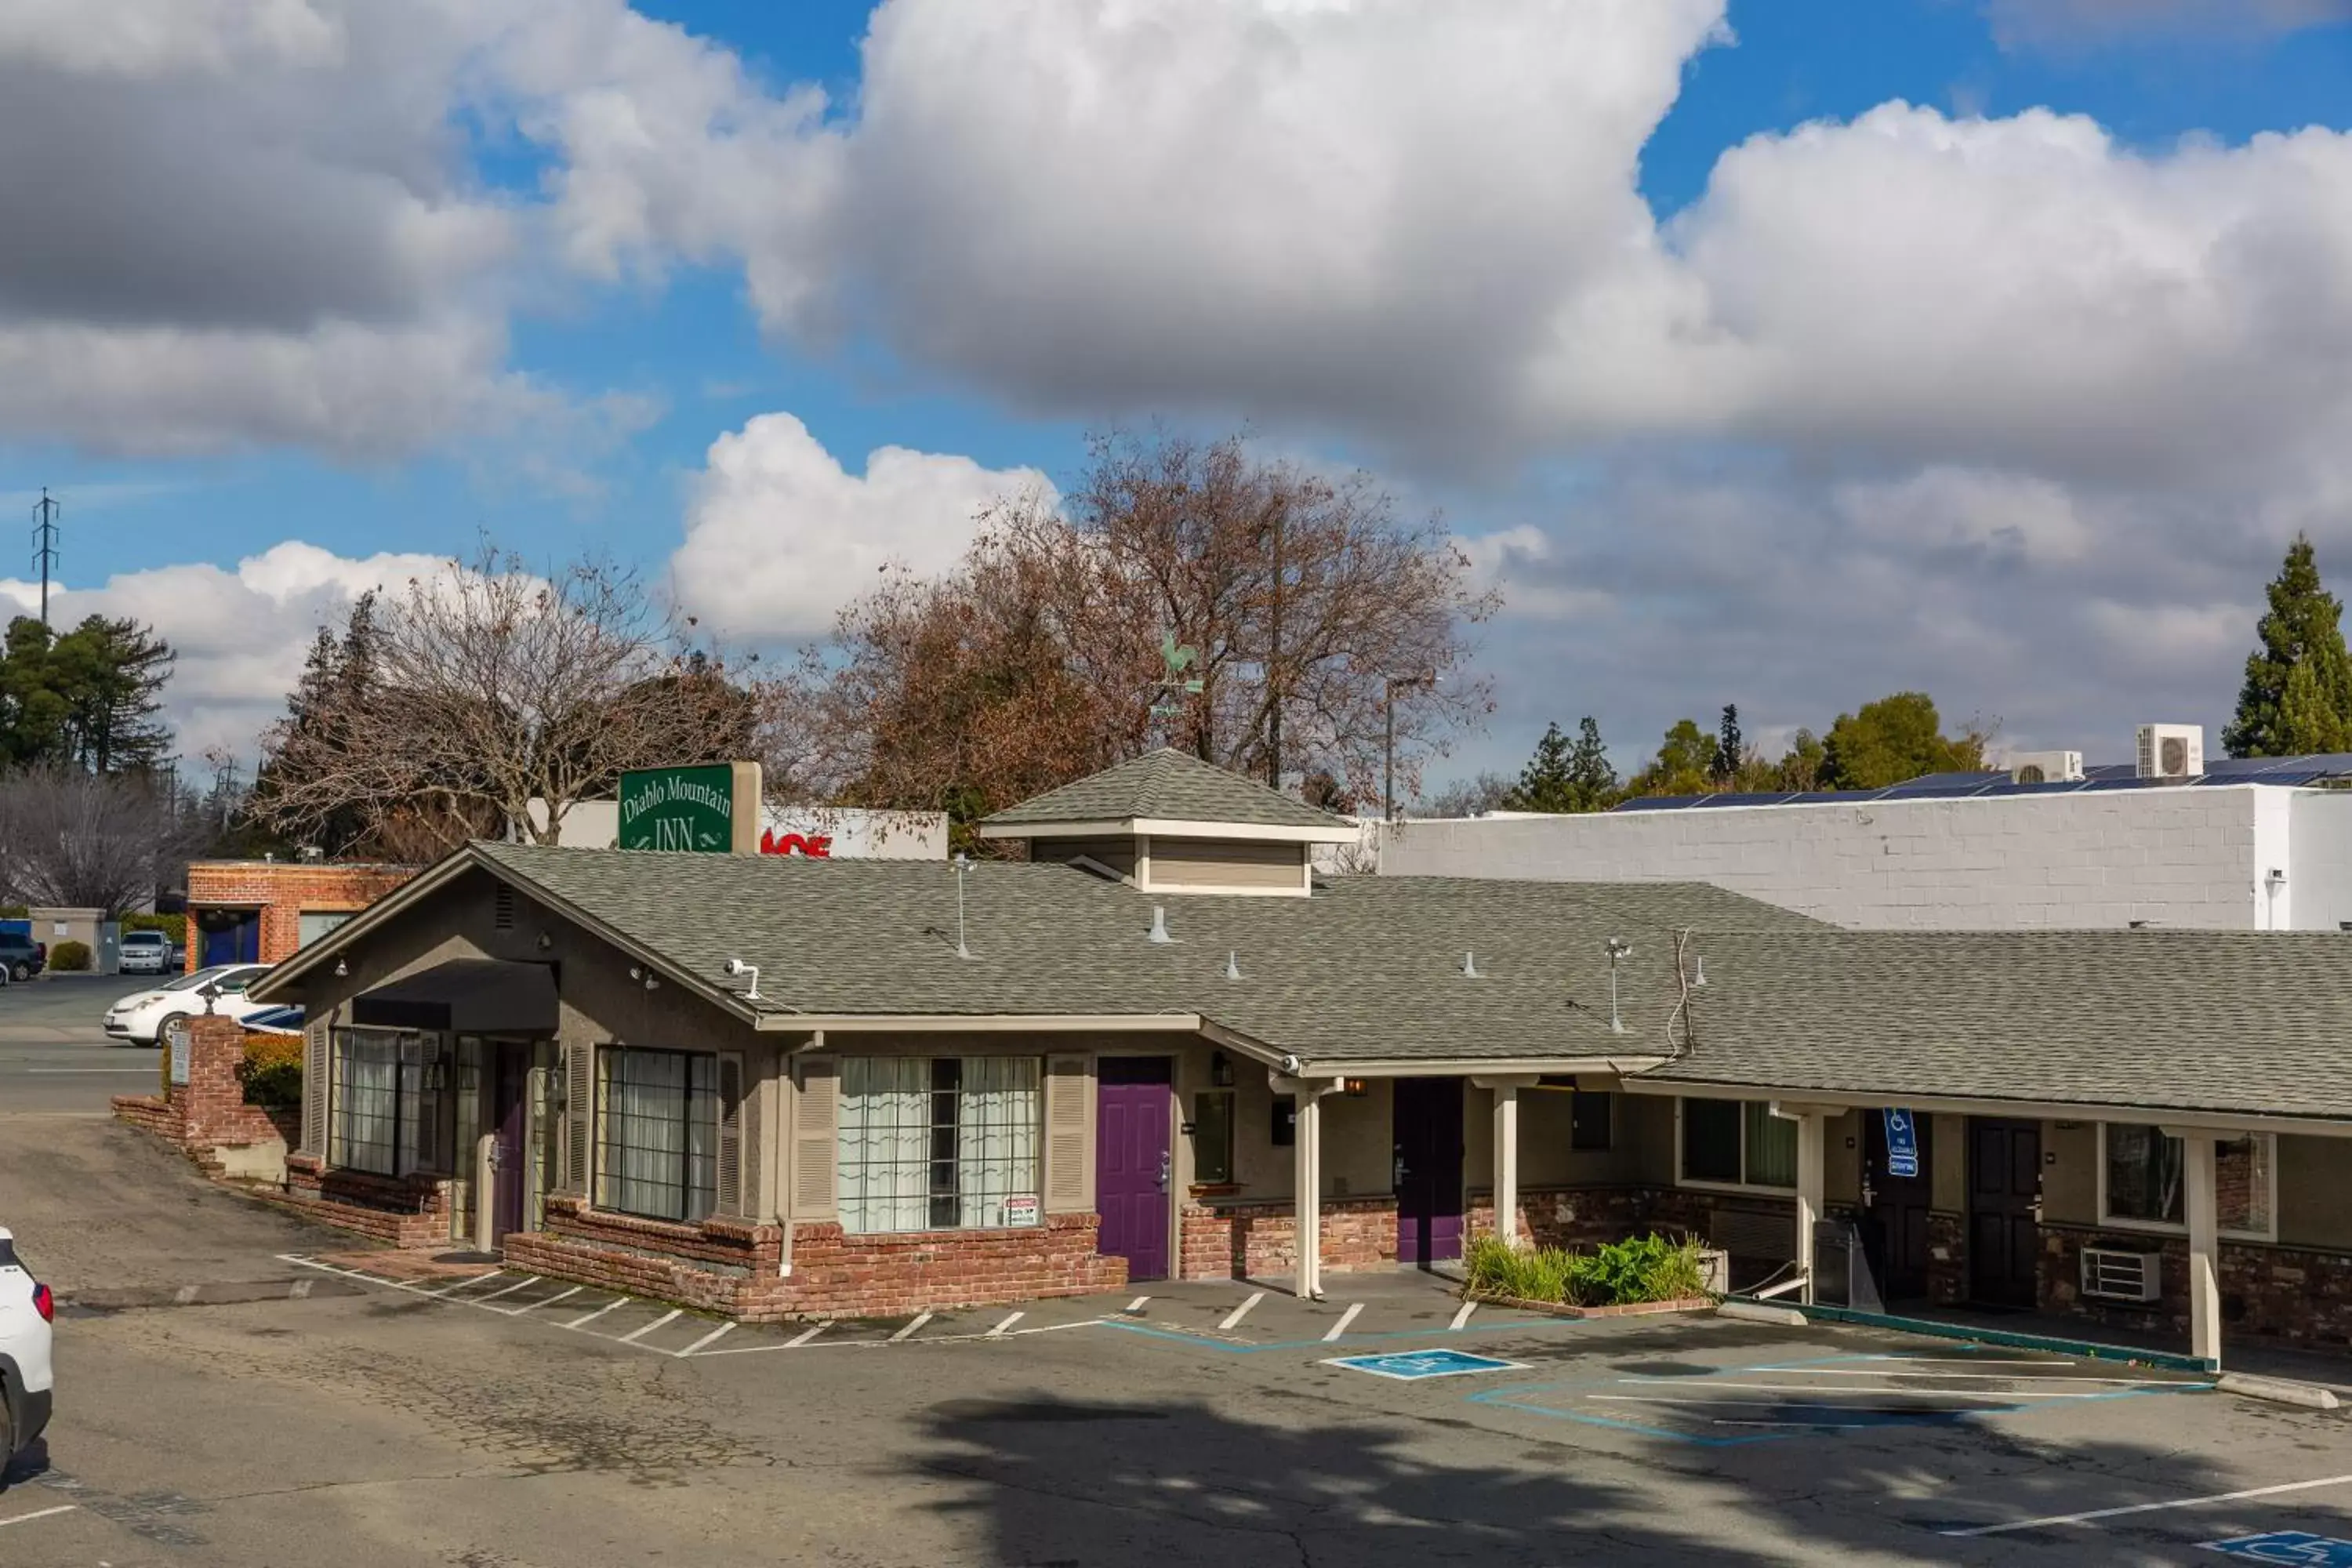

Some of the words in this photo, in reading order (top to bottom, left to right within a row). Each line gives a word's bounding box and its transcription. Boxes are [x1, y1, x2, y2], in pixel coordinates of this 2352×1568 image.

[623, 780, 664, 824] Diablo
[667, 775, 731, 818] Mountain
[655, 815, 695, 851] INN
